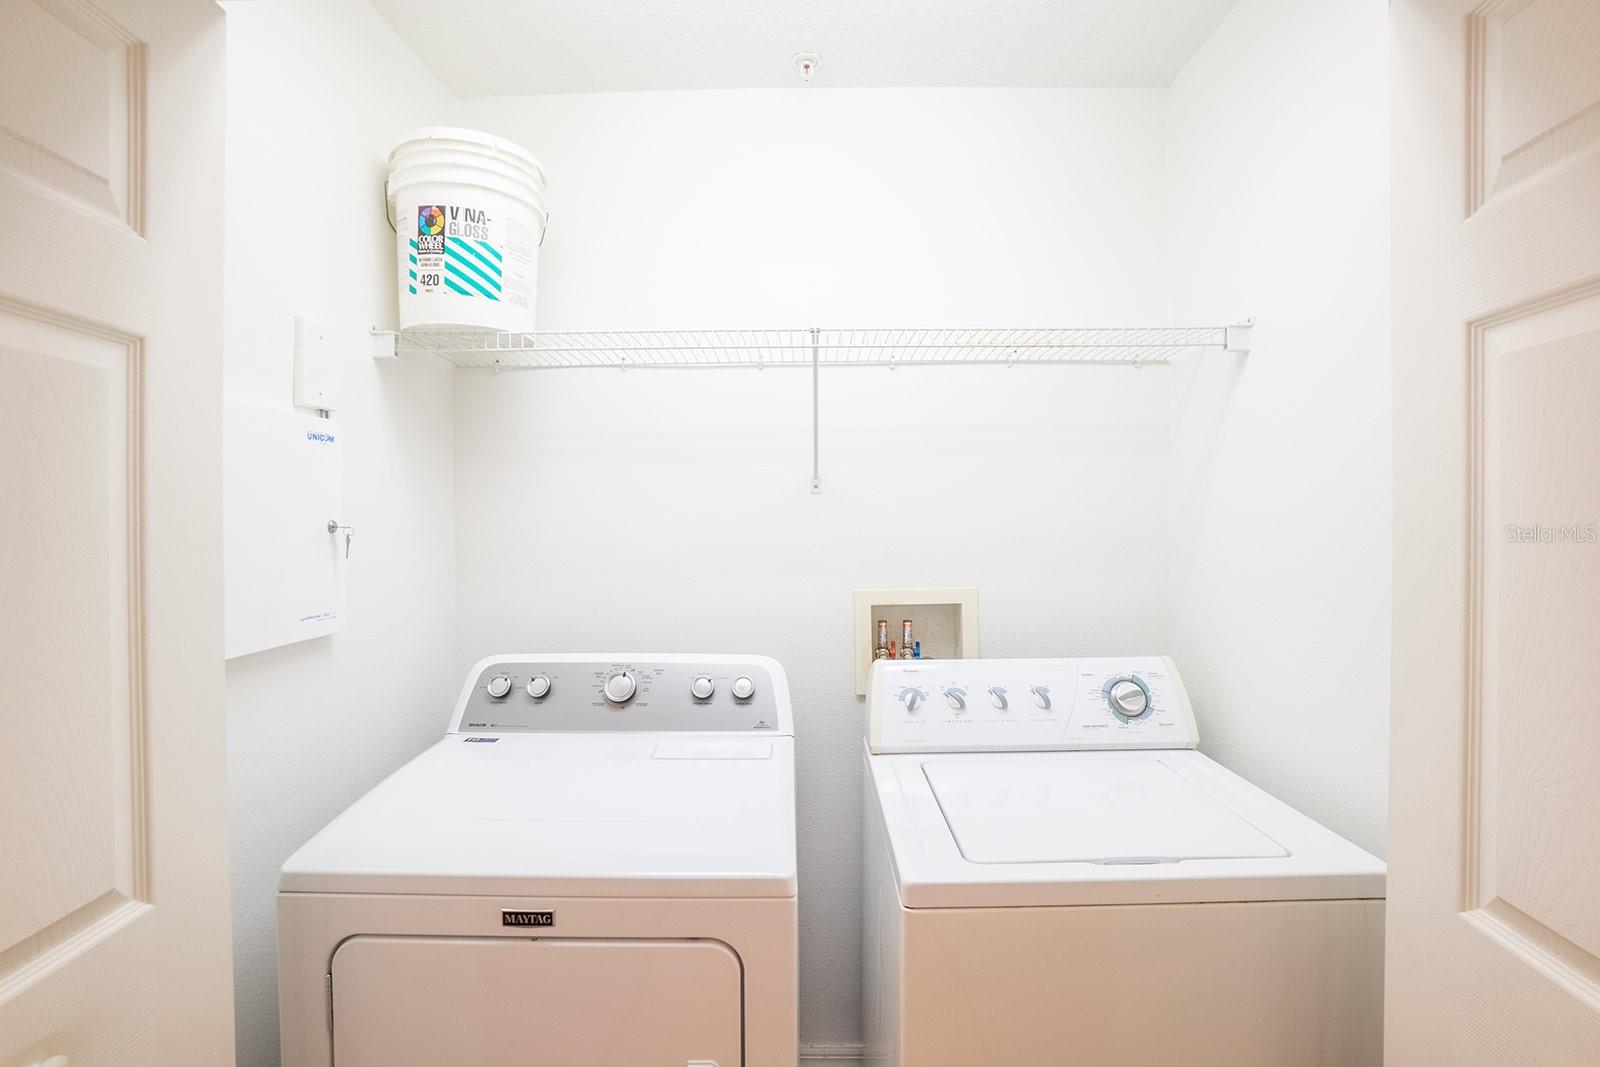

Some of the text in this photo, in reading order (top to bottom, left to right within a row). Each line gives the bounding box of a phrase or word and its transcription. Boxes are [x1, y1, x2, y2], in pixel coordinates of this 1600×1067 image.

[450, 205, 492, 226] VNA-
[418, 234, 445, 244] COLOR
[417, 241, 445, 251] WHEEL
[420, 273, 440, 287] 420
[504, 913, 552, 925] MAYTAG
